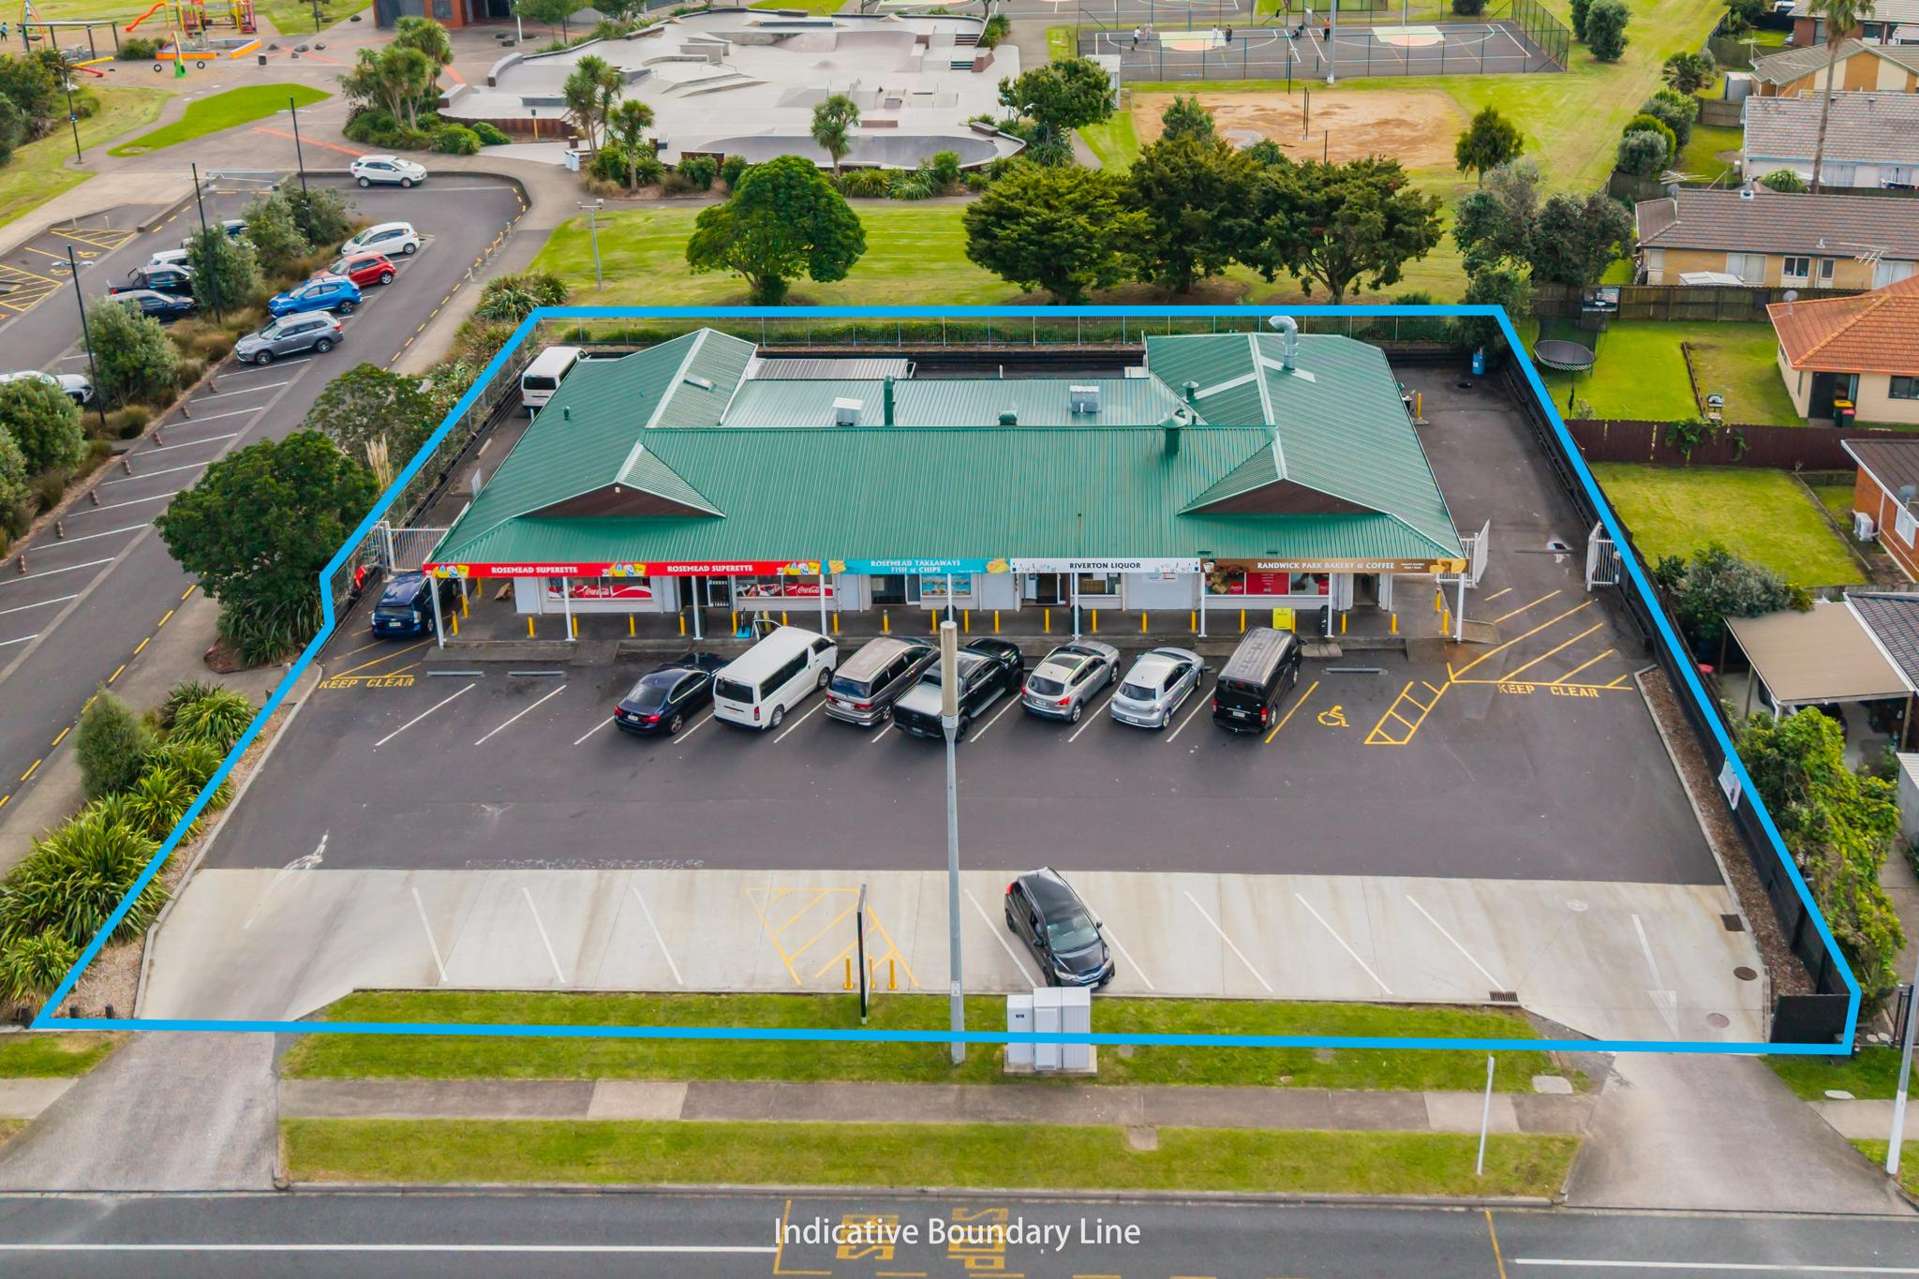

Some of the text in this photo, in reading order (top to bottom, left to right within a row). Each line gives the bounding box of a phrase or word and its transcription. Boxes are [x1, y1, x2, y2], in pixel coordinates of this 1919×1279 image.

[491, 566, 579, 574] ROSEMEAD SUPERETTE
[711, 564, 753, 572] SUPERETTE
[1110, 562, 1141, 570] LIQUOR
[319, 678, 415, 689] KEEP CLEAR
[1498, 683, 1600, 698] KEEP CLEAR
